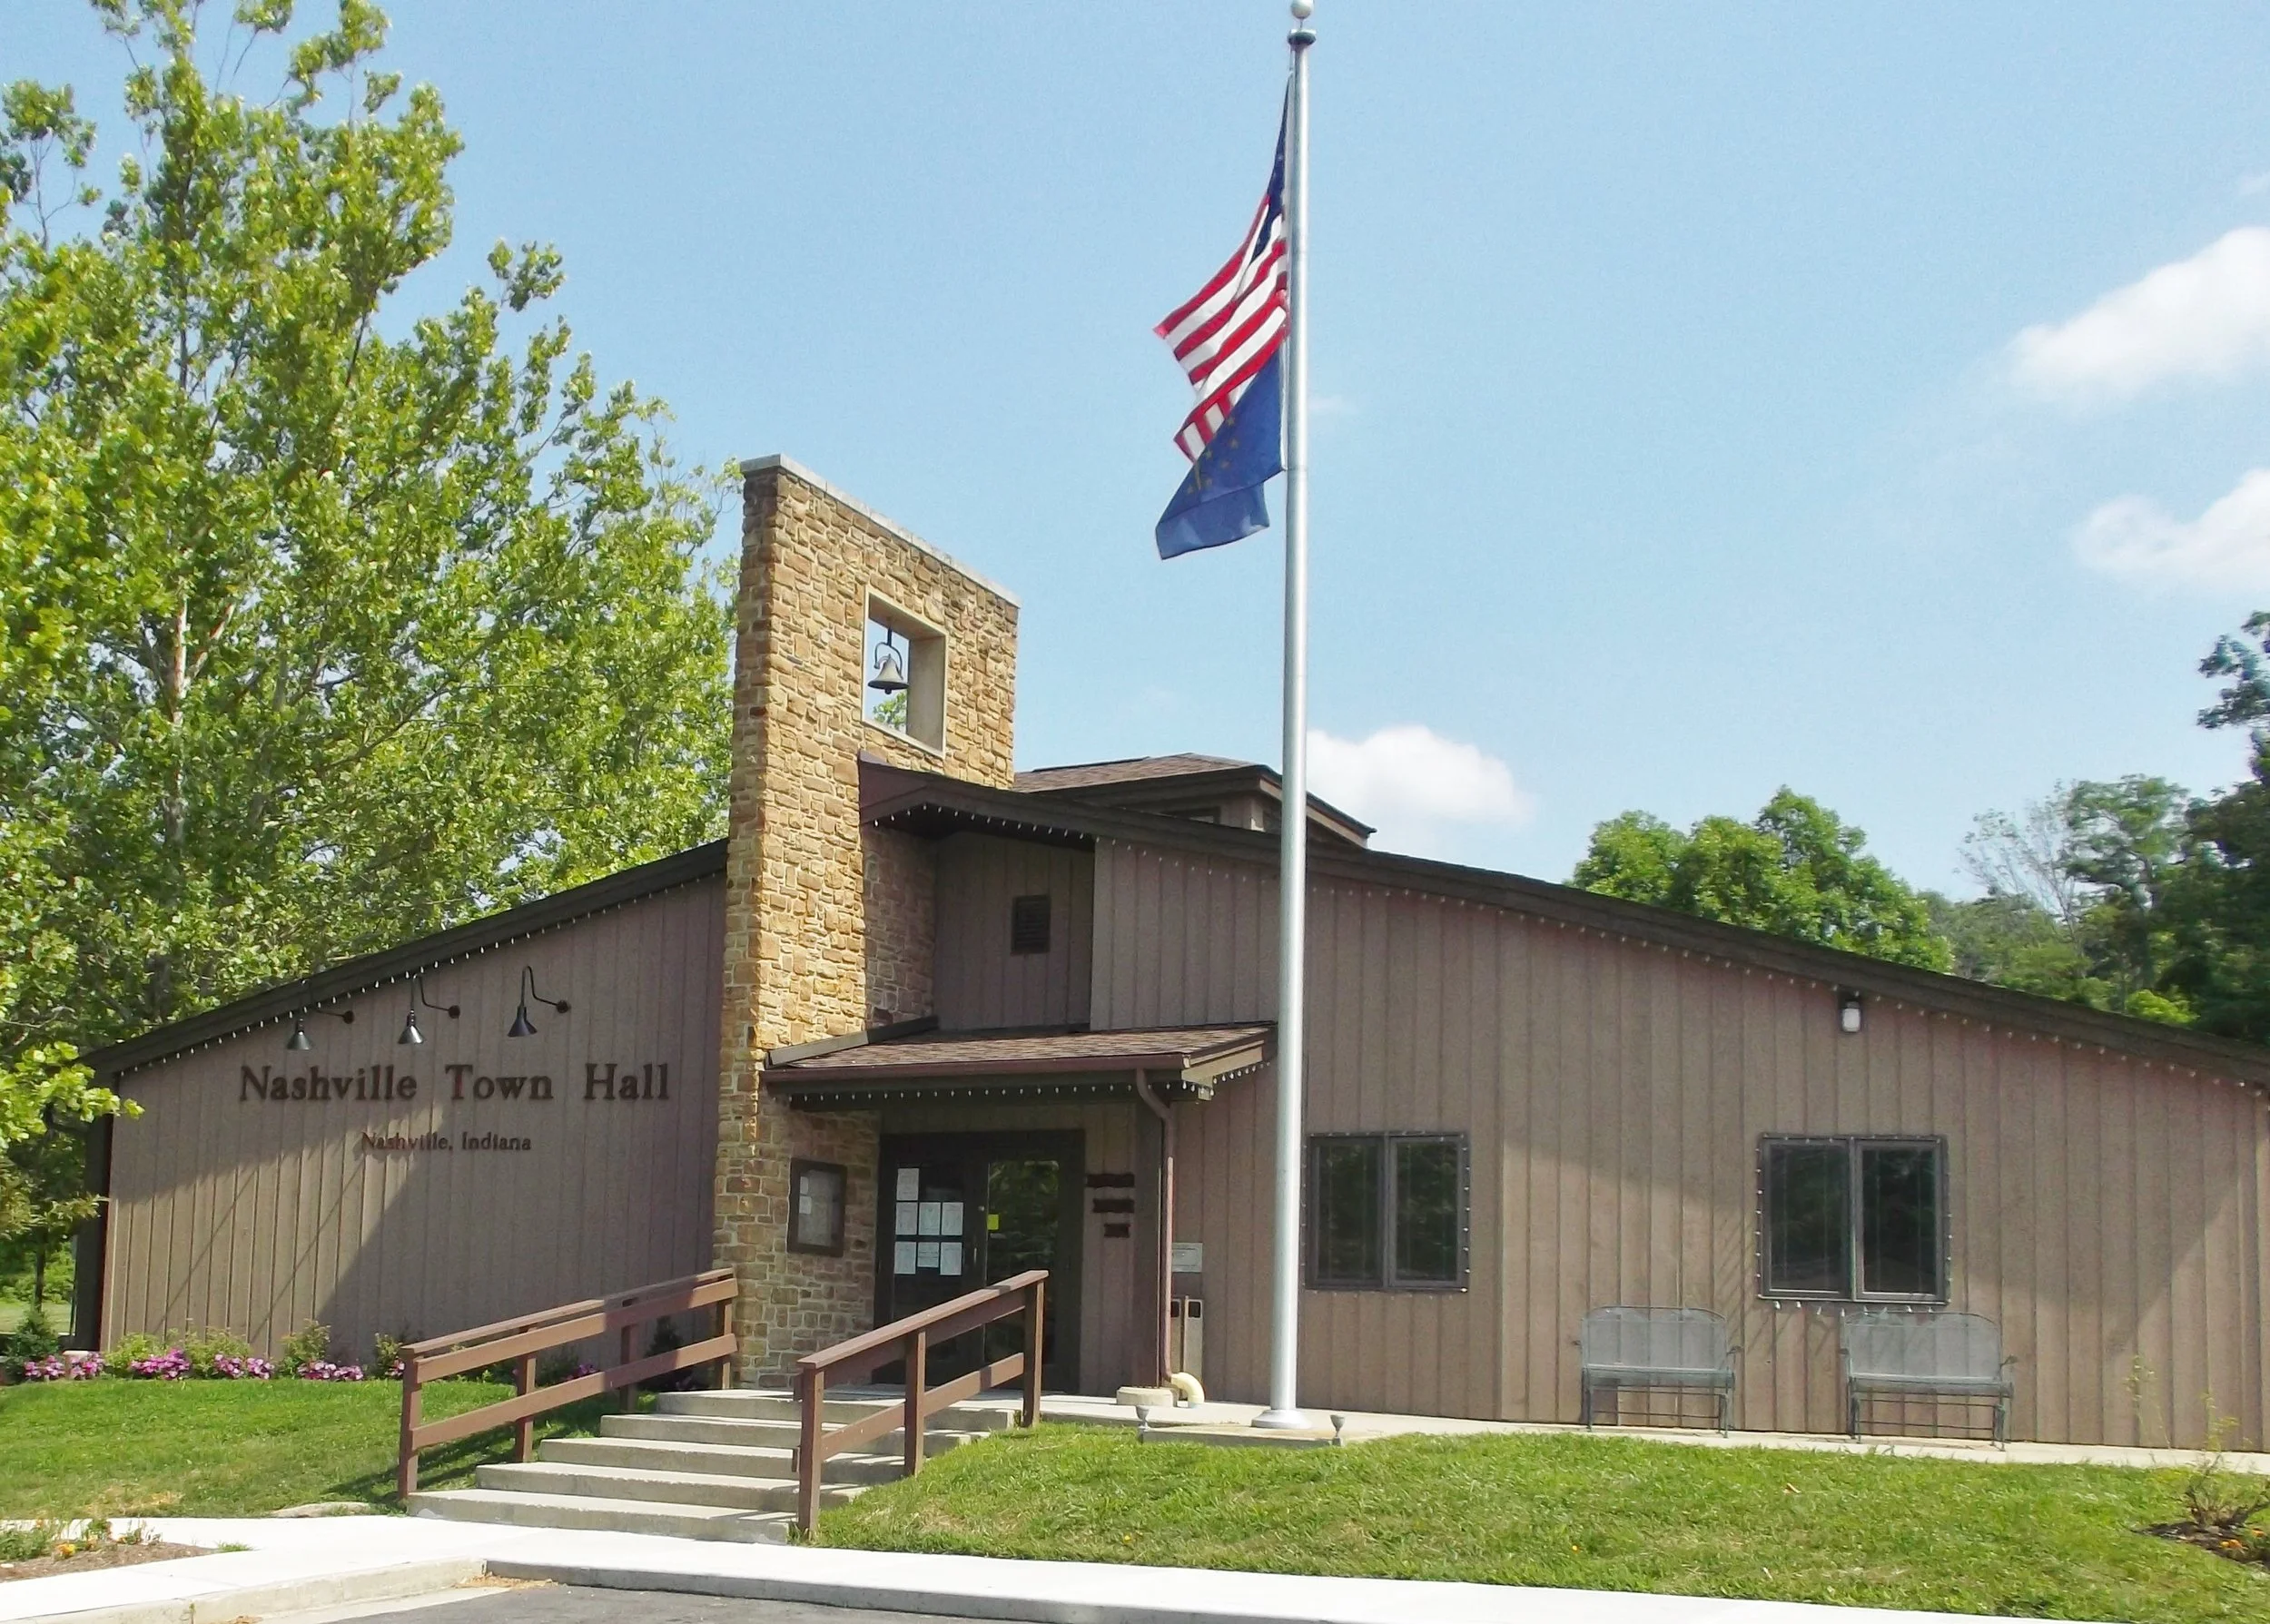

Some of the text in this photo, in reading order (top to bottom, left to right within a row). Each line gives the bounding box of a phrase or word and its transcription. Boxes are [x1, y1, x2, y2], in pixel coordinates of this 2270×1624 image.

[240, 1064, 669, 1101] Nashville Town Hall
[360, 1132, 531, 1152] Nashville, Indiana
